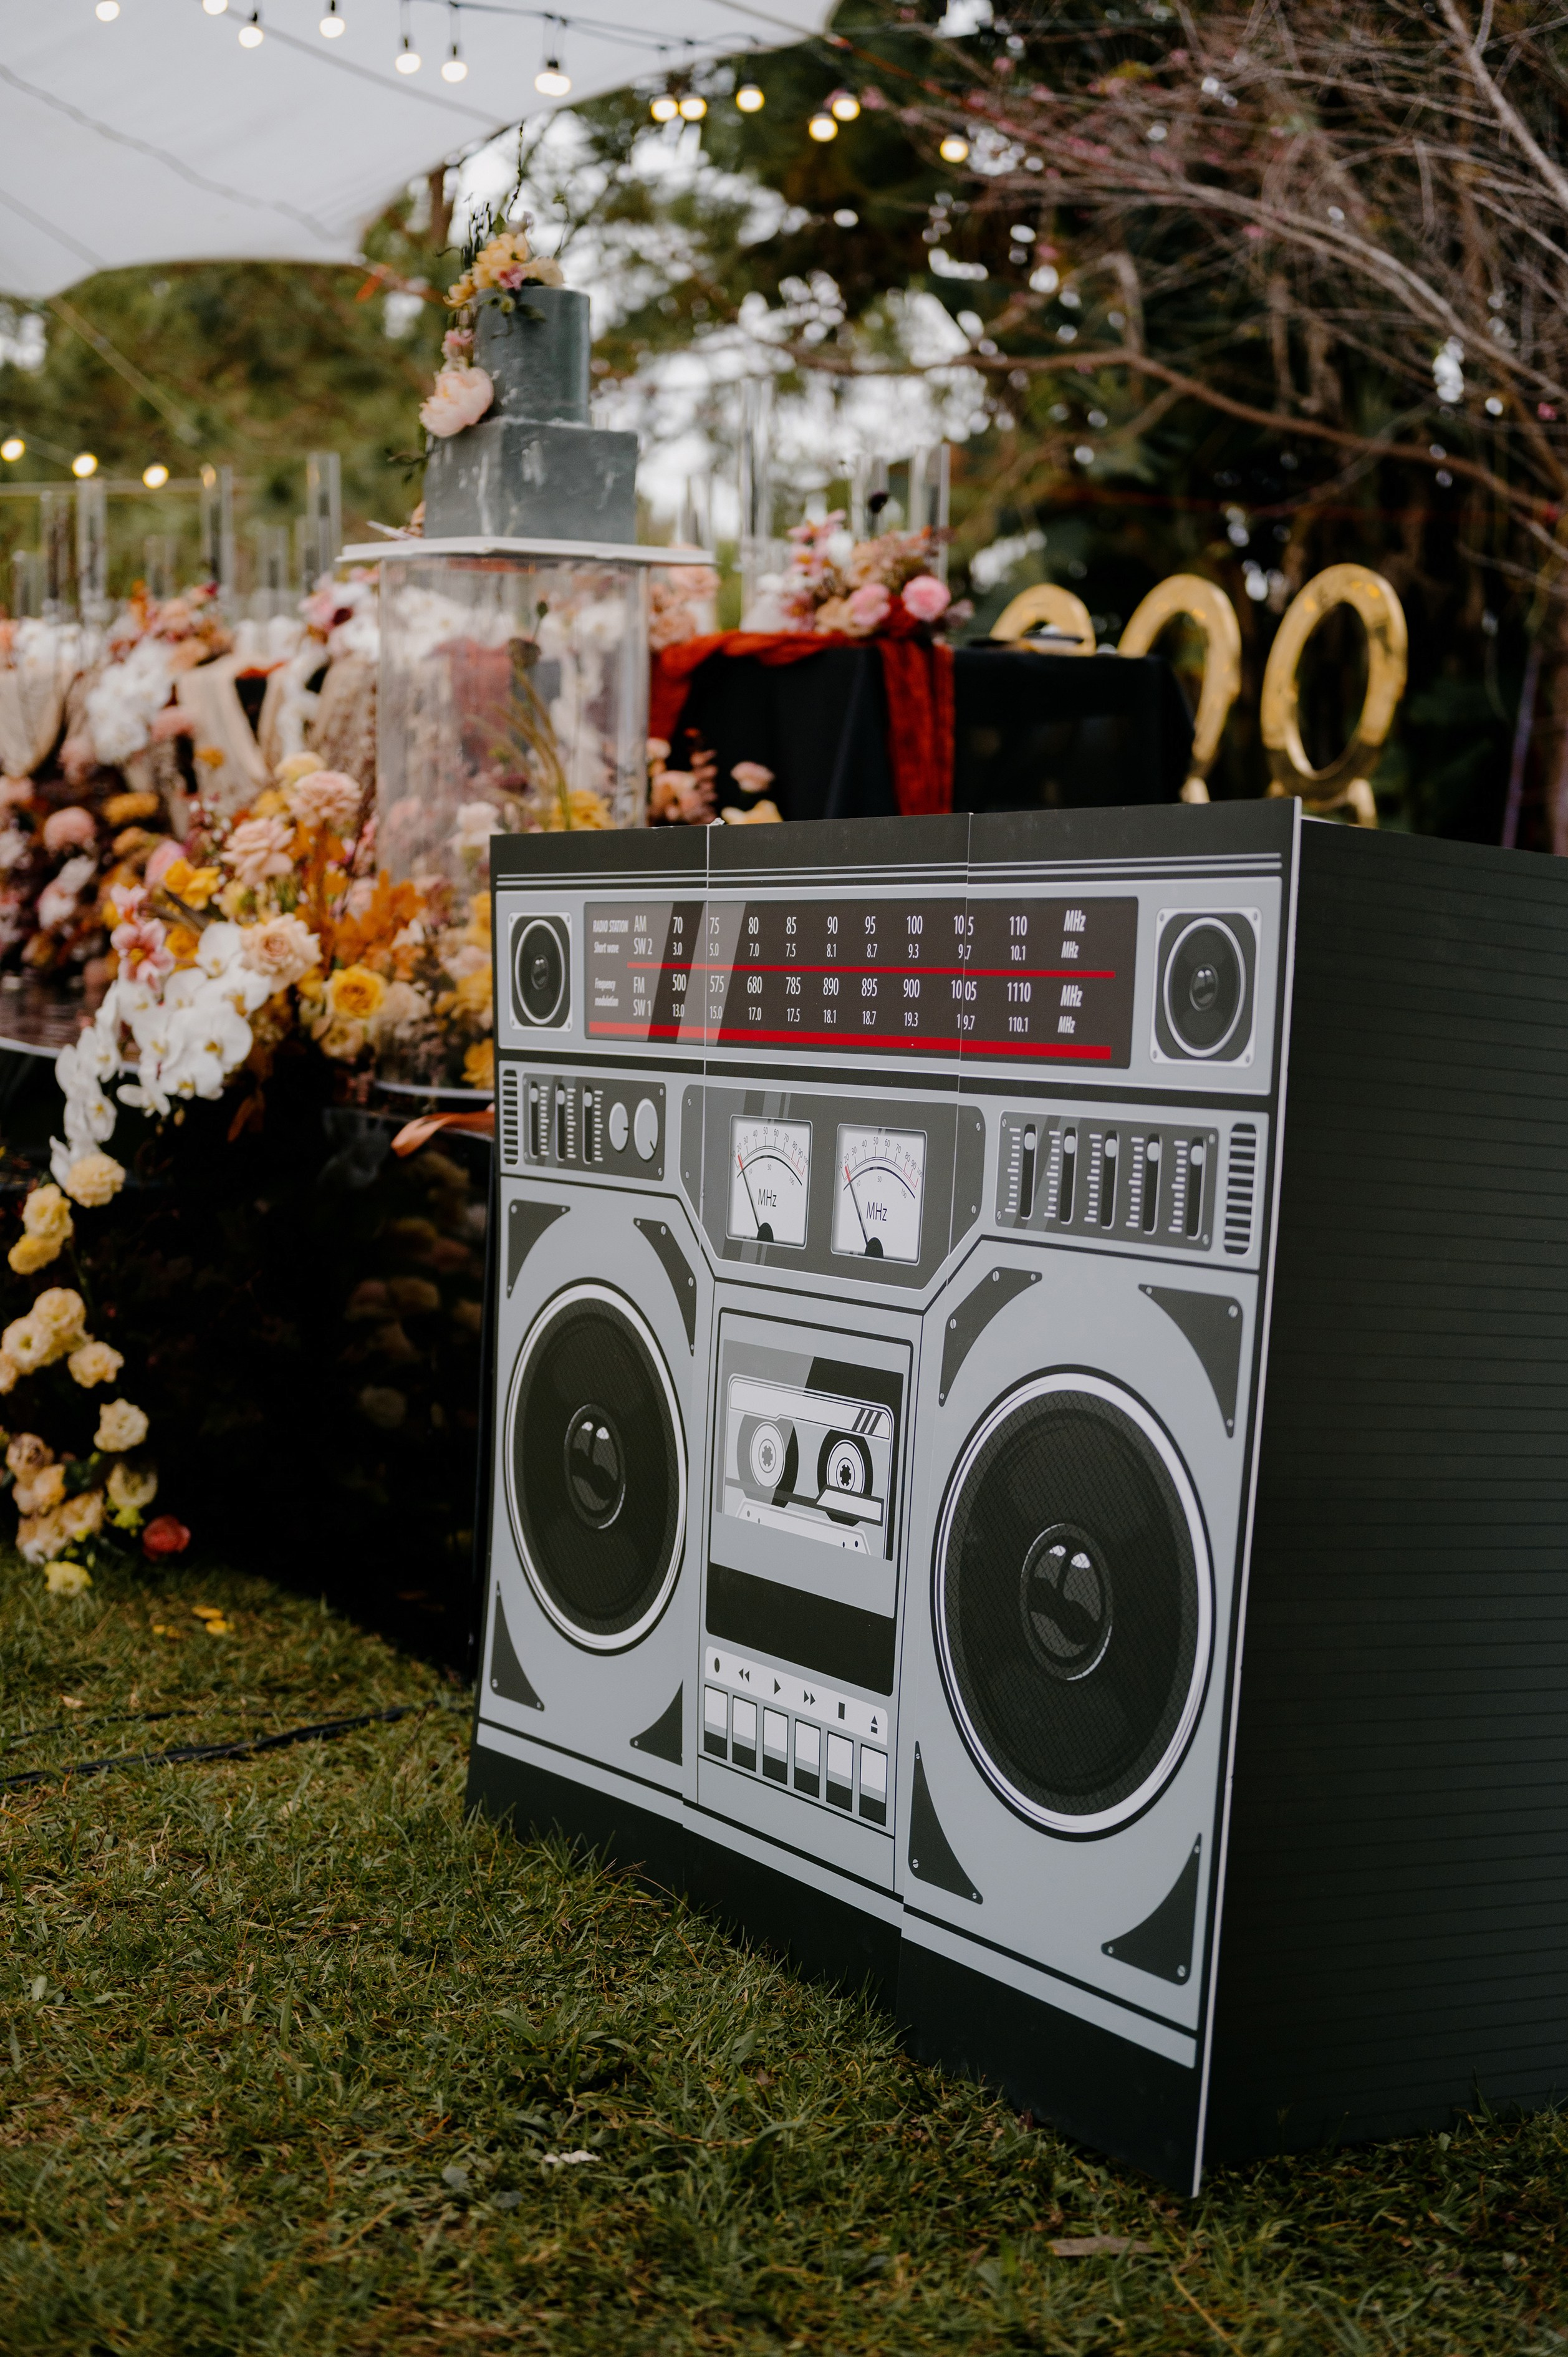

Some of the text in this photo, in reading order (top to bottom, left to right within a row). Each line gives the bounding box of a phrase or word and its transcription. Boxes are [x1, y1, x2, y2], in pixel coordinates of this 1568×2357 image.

[633, 915, 647, 932] AM
[673, 916, 683, 934] 70
[709, 917, 719, 934] 75
[748, 917, 759, 934] 80
[786, 917, 797, 935] 85
[827, 916, 838, 935] 90
[865, 916, 876, 935] 95
[907, 916, 923, 935] 100
[1009, 916, 1027, 936] 110
[1064, 910, 1086, 932] MHz
[633, 937, 647, 955] SW
[647, 938, 653, 955] 2
[673, 942, 682, 955] 3.0
[709, 943, 719, 957] 5.0
[749, 943, 759, 957] 7.0
[786, 943, 796, 957] 7.5
[827, 944, 837, 957] 8.1
[867, 944, 877, 958] 8.7
[908, 944, 919, 958] 9.3
[1011, 945, 1026, 961] 10.1
[1061, 941, 1079, 958] MHz
[633, 976, 645, 993] FM
[672, 973, 686, 991] 500
[709, 975, 724, 993] 575
[747, 976, 762, 994] 680
[786, 976, 801, 995] 785
[823, 977, 839, 996] 890
[861, 978, 877, 996] 895
[903, 979, 920, 998] 900
[1007, 982, 1031, 1003] 1110
[1060, 985, 1082, 1007] MHz
[633, 998, 646, 1016] SW
[647, 1000, 652, 1016] 1
[673, 1004, 685, 1018] 13.0
[709, 1005, 722, 1019] 15.0
[749, 1007, 762, 1021] 17.0
[787, 1008, 800, 1023] 17.5
[824, 1009, 837, 1023] 18.1
[862, 1010, 876, 1025] 18.7
[904, 1012, 918, 1027] 19.3
[1008, 1016, 1029, 1033] 110.1
[1057, 1016, 1075, 1034] MHz
[838, 1161, 844, 1172] 10
[844, 1153, 850, 1164] 20
[851, 1146, 857, 1156] 30
[861, 1139, 867, 1148] 40
[873, 1137, 879, 1145] 50
[884, 1139, 891, 1148] 60
[895, 1143, 902, 1154] 70
[905, 1151, 911, 1162] 80
[910, 1159, 917, 1170] 90
[758, 1188, 777, 1207] MHz
[866, 1201, 888, 1222] MHz
